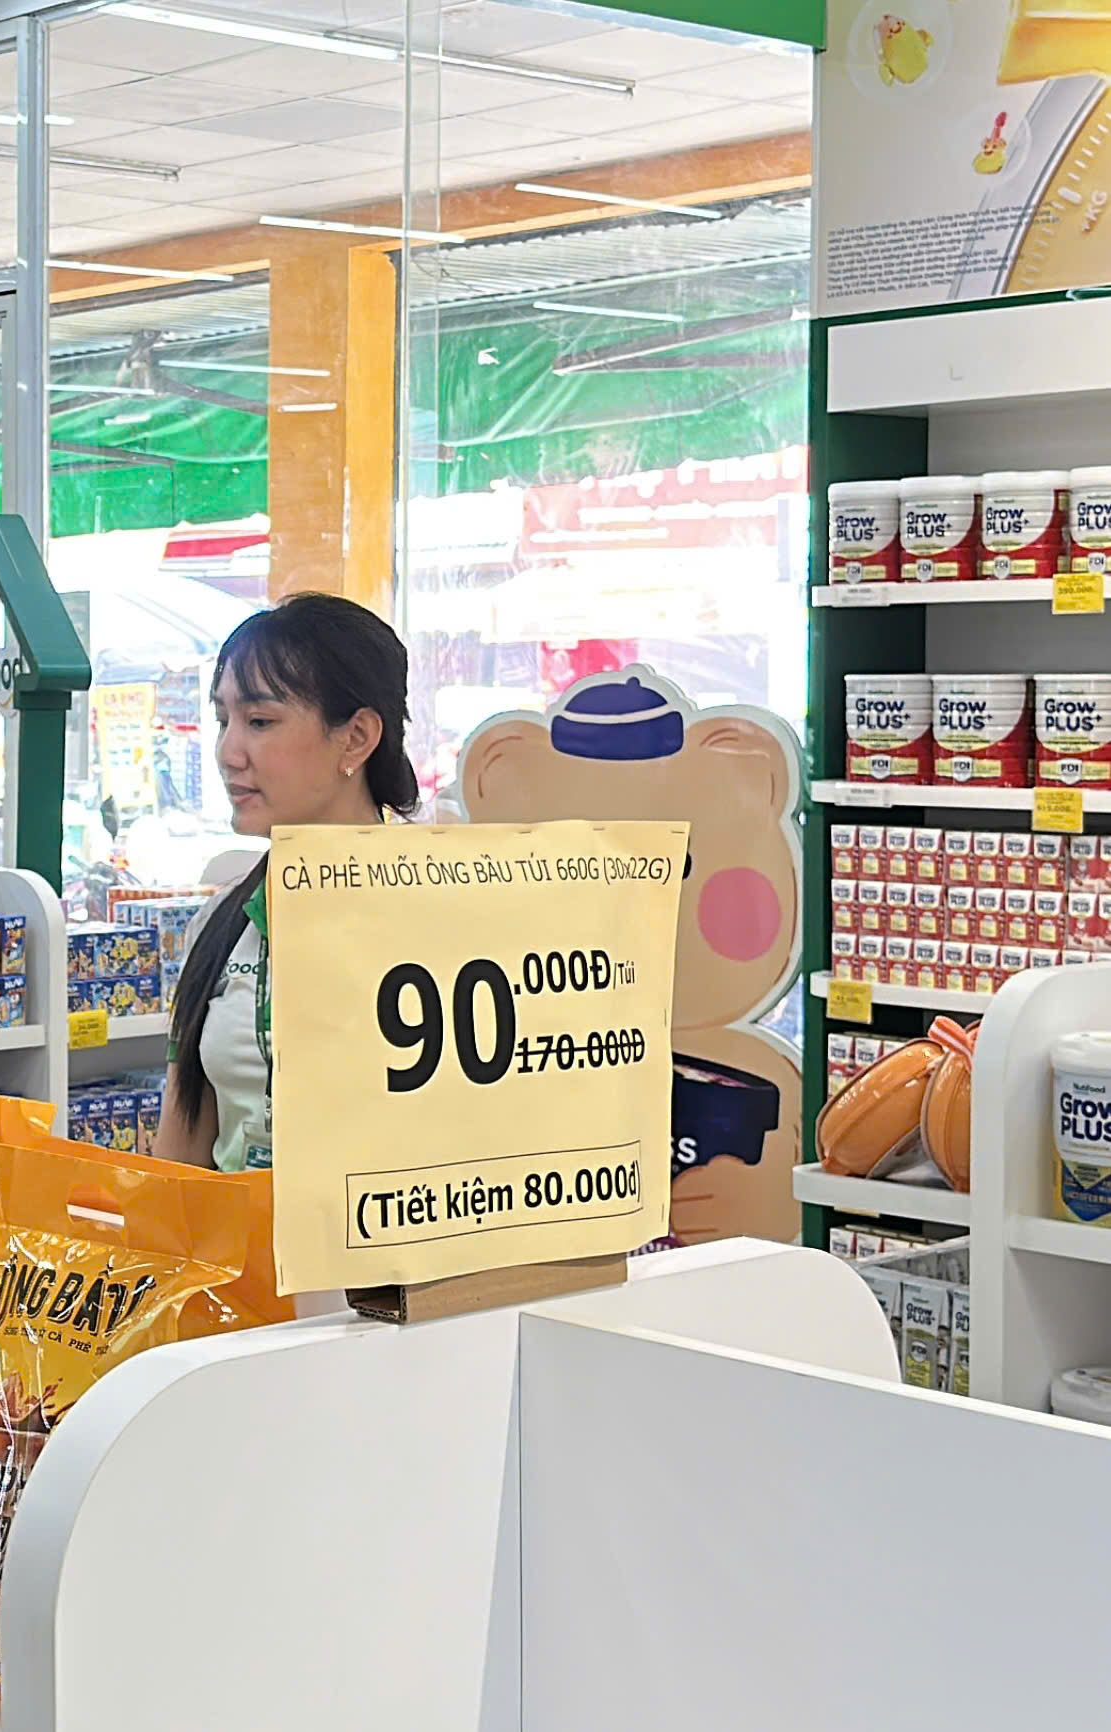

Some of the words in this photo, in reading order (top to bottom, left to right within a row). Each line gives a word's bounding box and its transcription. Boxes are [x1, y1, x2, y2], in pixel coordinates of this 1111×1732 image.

[906, 512, 946, 524] Grow
[986, 507, 1024, 520] Grow
[836, 516, 875, 528] Grow
[856, 698, 905, 712] Grow
[939, 698, 986, 712] Grow
[1045, 698, 1096, 714] Grow
[282, 857, 312, 890] CÀ
[320, 856, 361, 888] PHÊ
[426, 855, 470, 885] ÔNG
[473, 854, 513, 883] BẦU
[515, 852, 552, 882] TÚI
[556, 857, 600, 881] 660G
[603, 857, 672, 885] (30x22G)
[376, 959, 516, 1093] 90
[357, 1184, 437, 1239] (Tiết
[446, 1176, 513, 1224] kiệm
[524, 1160, 640, 1208] 80.000đ)
